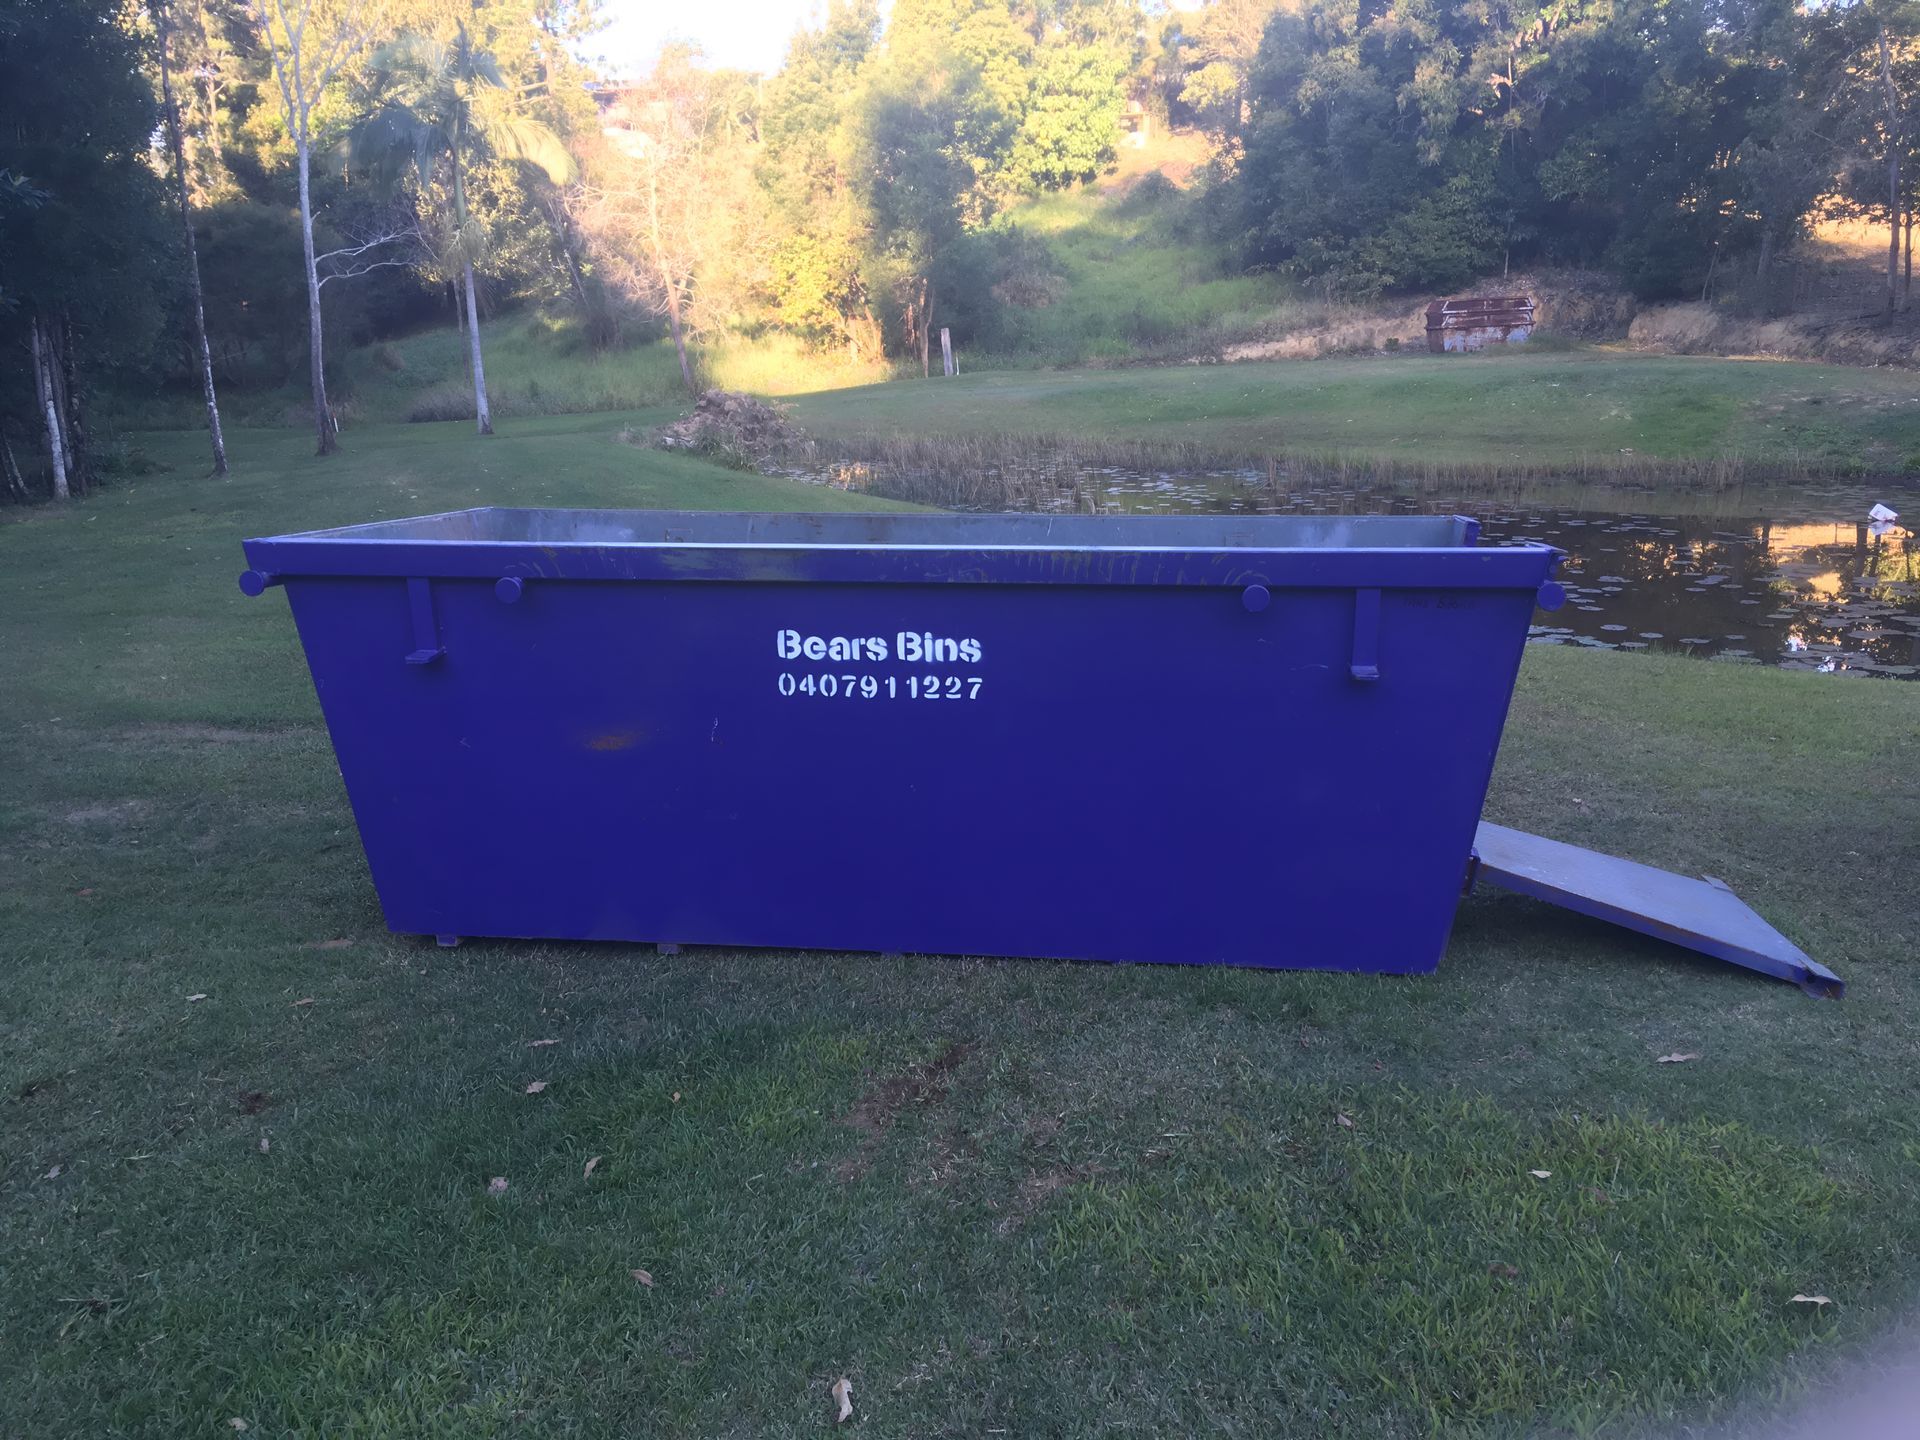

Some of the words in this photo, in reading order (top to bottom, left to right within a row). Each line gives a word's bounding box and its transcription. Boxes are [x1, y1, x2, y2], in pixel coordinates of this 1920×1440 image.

[776, 629, 889, 662] Bears
[896, 631, 982, 663] Bins
[777, 672, 983, 700] 0407911227
